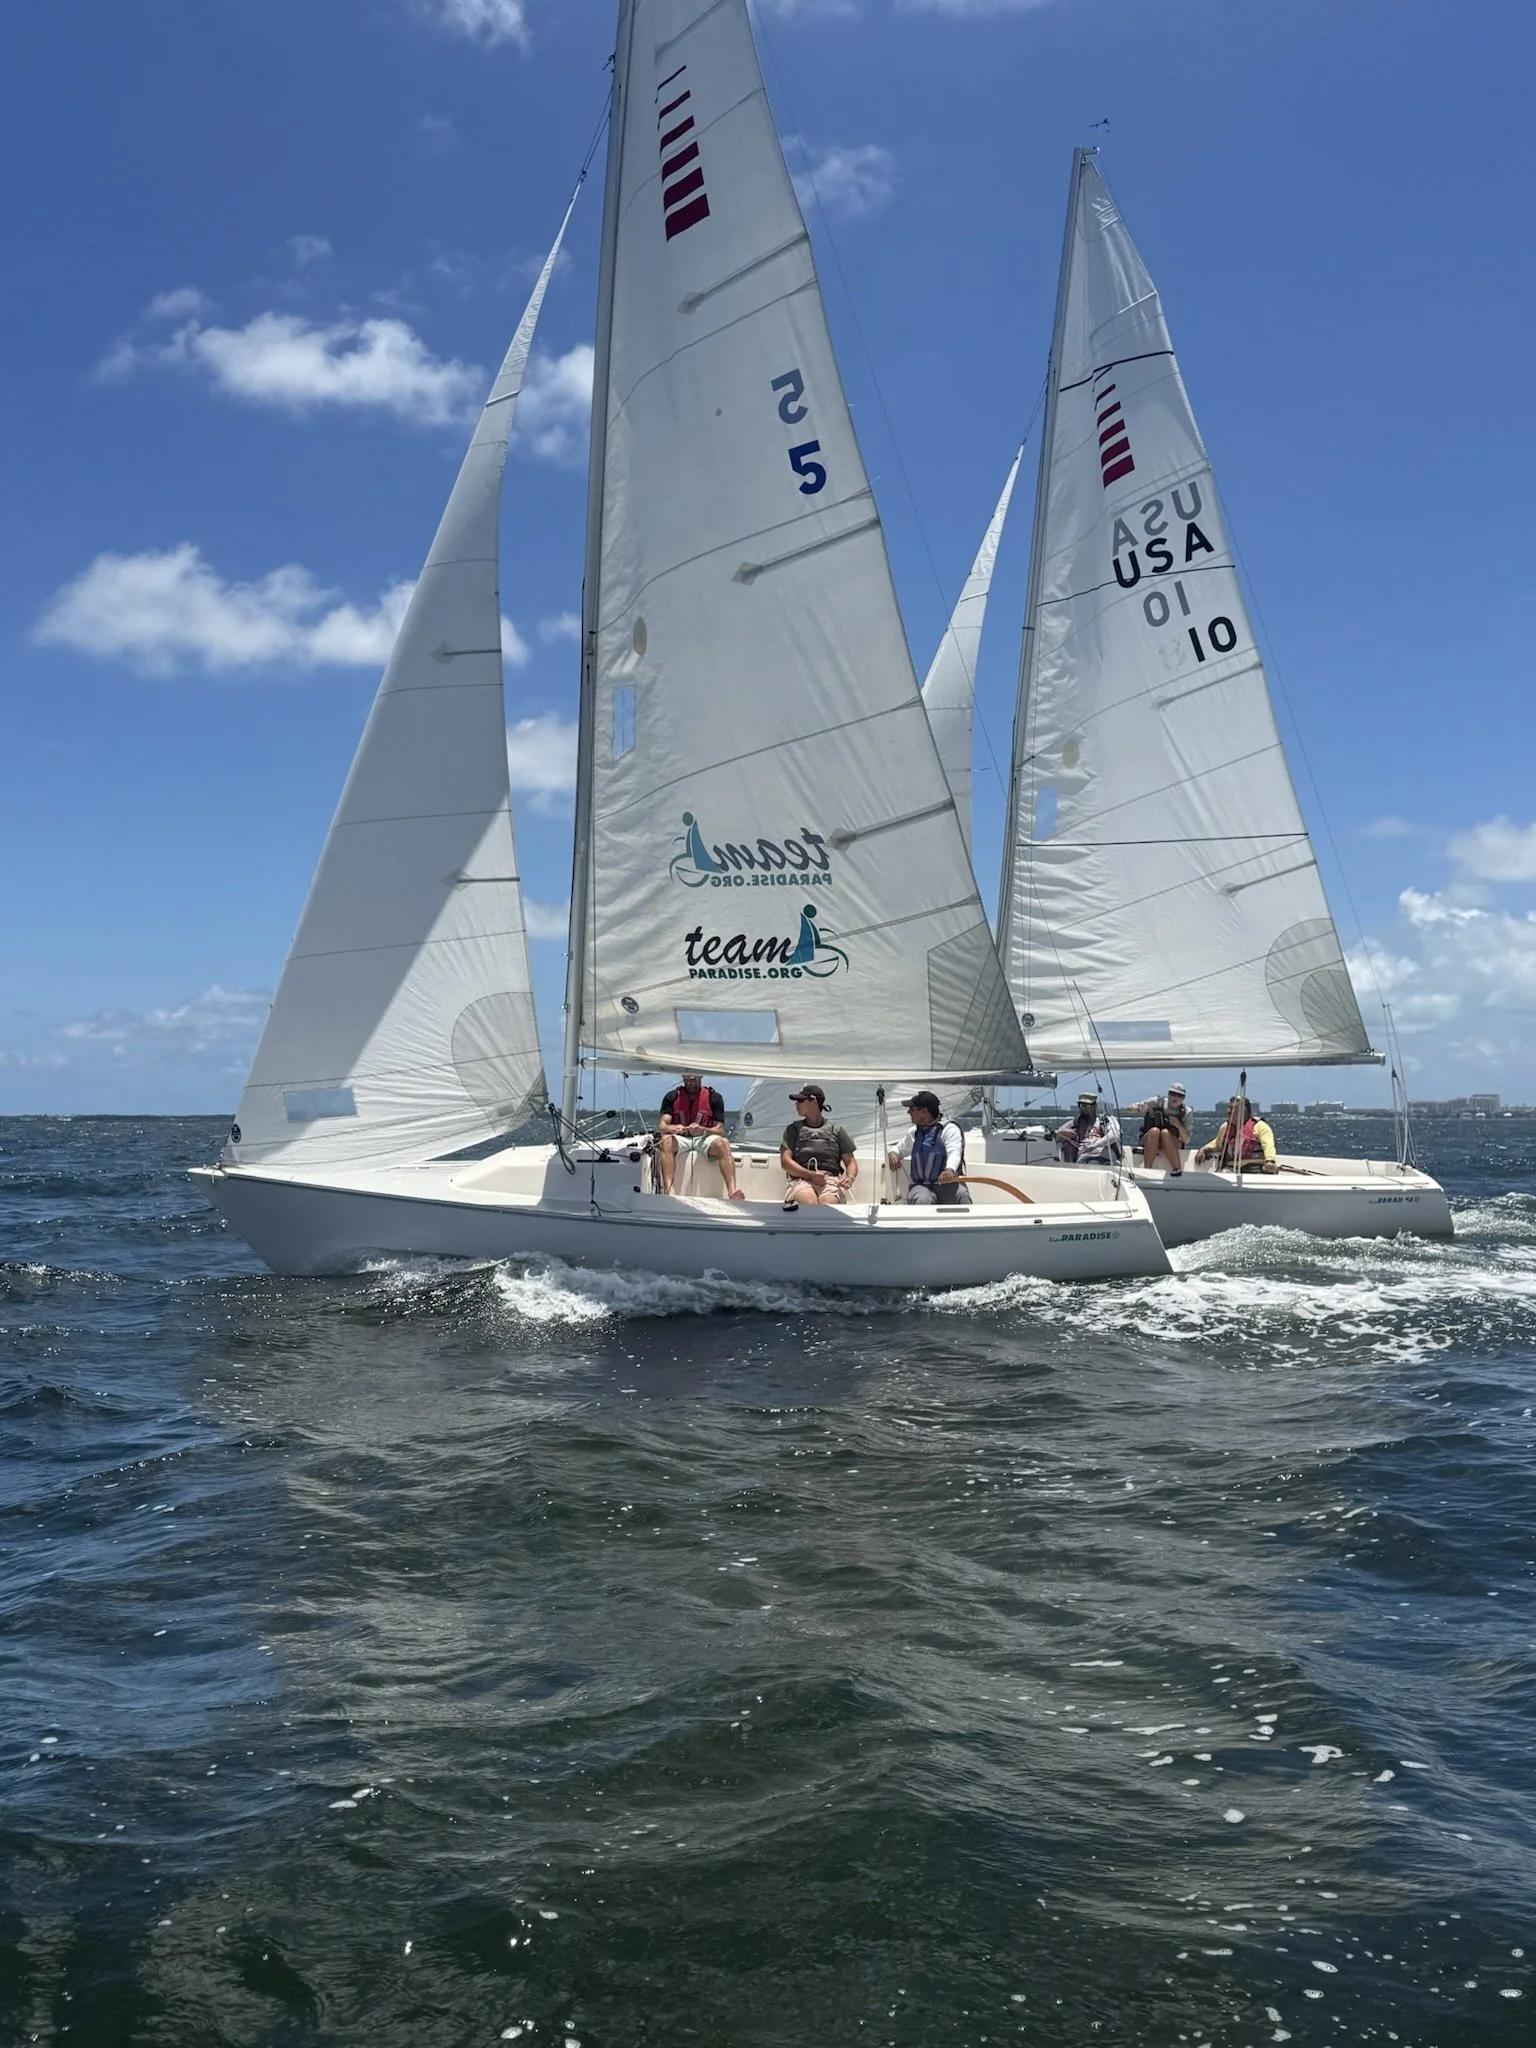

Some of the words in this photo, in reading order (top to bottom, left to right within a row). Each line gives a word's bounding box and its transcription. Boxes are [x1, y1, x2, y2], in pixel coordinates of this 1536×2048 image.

[788, 439, 826, 495] 5
[1113, 522, 1215, 588] USA
[1188, 616, 1237, 663] 10
[685, 926, 794, 966] team
[689, 967, 803, 979] PARADISE.ORG
[1061, 1231, 1112, 1242] PARADISE
